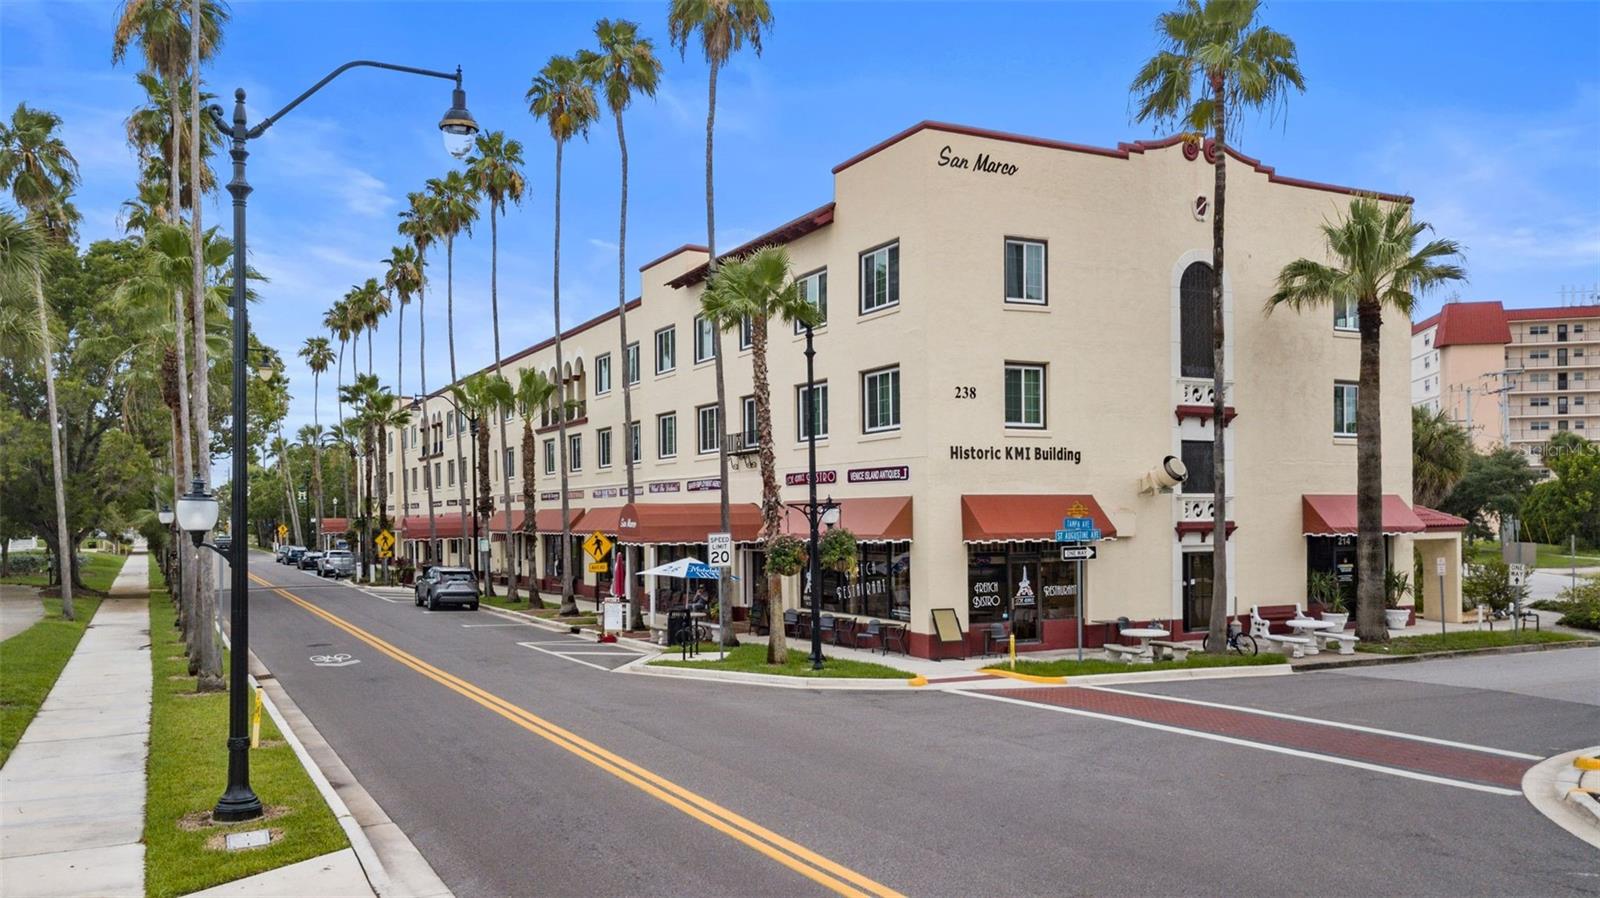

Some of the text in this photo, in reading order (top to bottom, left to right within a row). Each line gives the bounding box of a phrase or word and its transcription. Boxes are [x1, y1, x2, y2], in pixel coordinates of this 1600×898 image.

[937, 145, 1019, 176] San Marco
[954, 386, 977, 399] 238
[950, 445, 1081, 465] Historic KMI Building
[850, 468, 901, 481] VENICE ISLAND ANTIQUES
[711, 551, 730, 564] 20
[972, 595, 1000, 608] BISTRO
